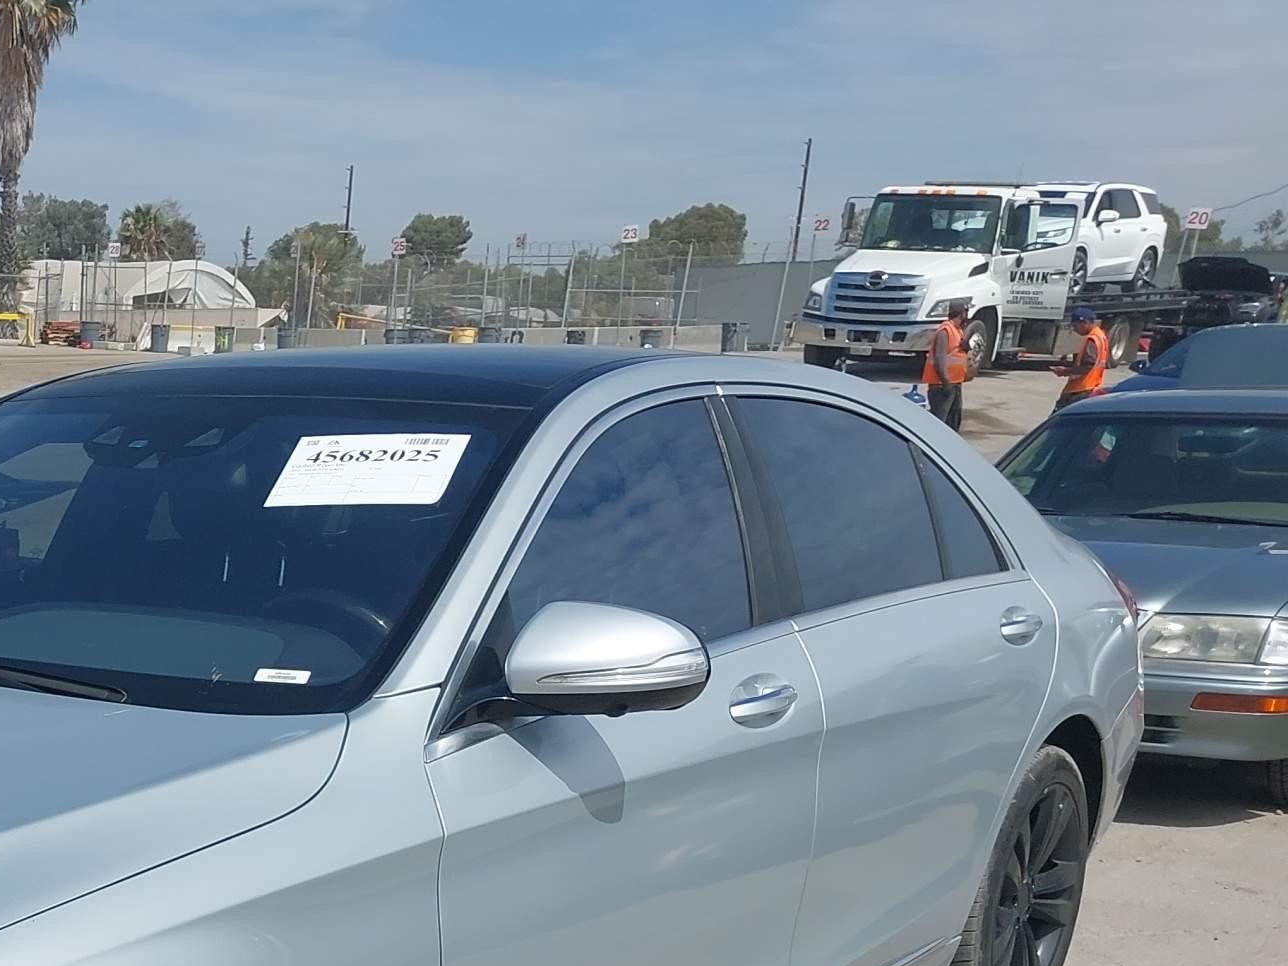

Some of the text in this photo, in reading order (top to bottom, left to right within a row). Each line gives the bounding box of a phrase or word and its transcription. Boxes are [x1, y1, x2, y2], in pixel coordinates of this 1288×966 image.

[1187, 211, 1209, 225] 20
[814, 219, 830, 231] 22
[623, 228, 638, 240] 23
[393, 240, 406, 252] 25
[1009, 271, 1050, 284] VANIK
[306, 449, 442, 463] 45682025
